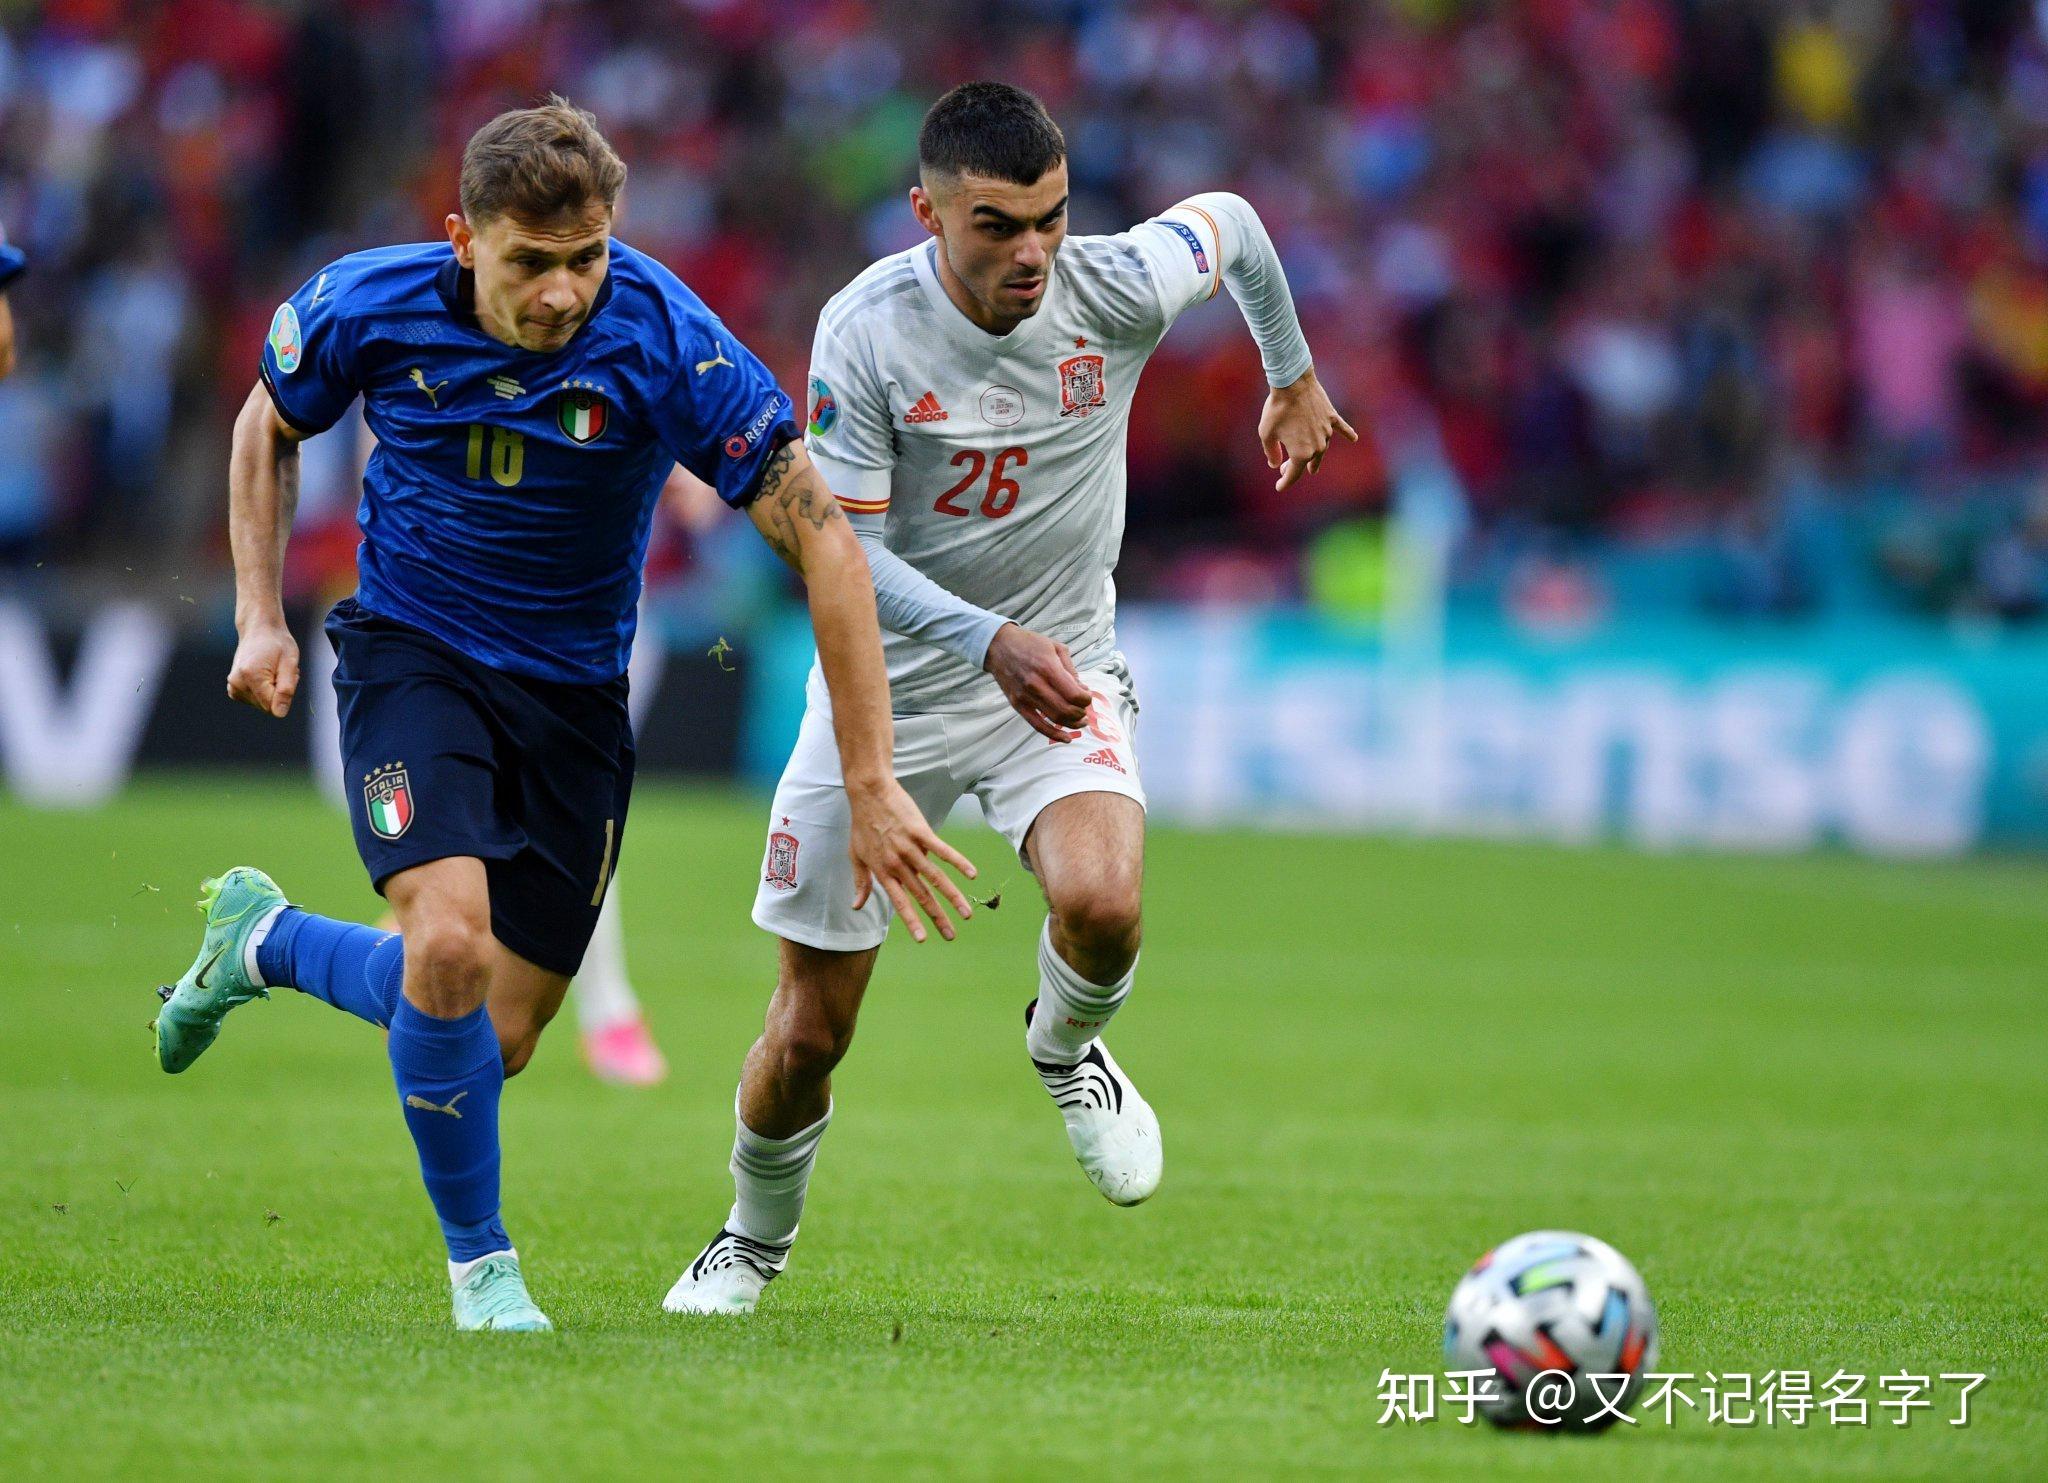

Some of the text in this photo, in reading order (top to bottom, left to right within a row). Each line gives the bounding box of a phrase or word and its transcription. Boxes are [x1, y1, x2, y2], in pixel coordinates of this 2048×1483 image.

[744, 396, 780, 443] RESPECT
[903, 411, 949, 423] adidas
[466, 424, 524, 487] 18
[933, 447, 1028, 518] 26
[1083, 757, 1127, 774] adidas
[368, 775, 404, 798] ITALIA
